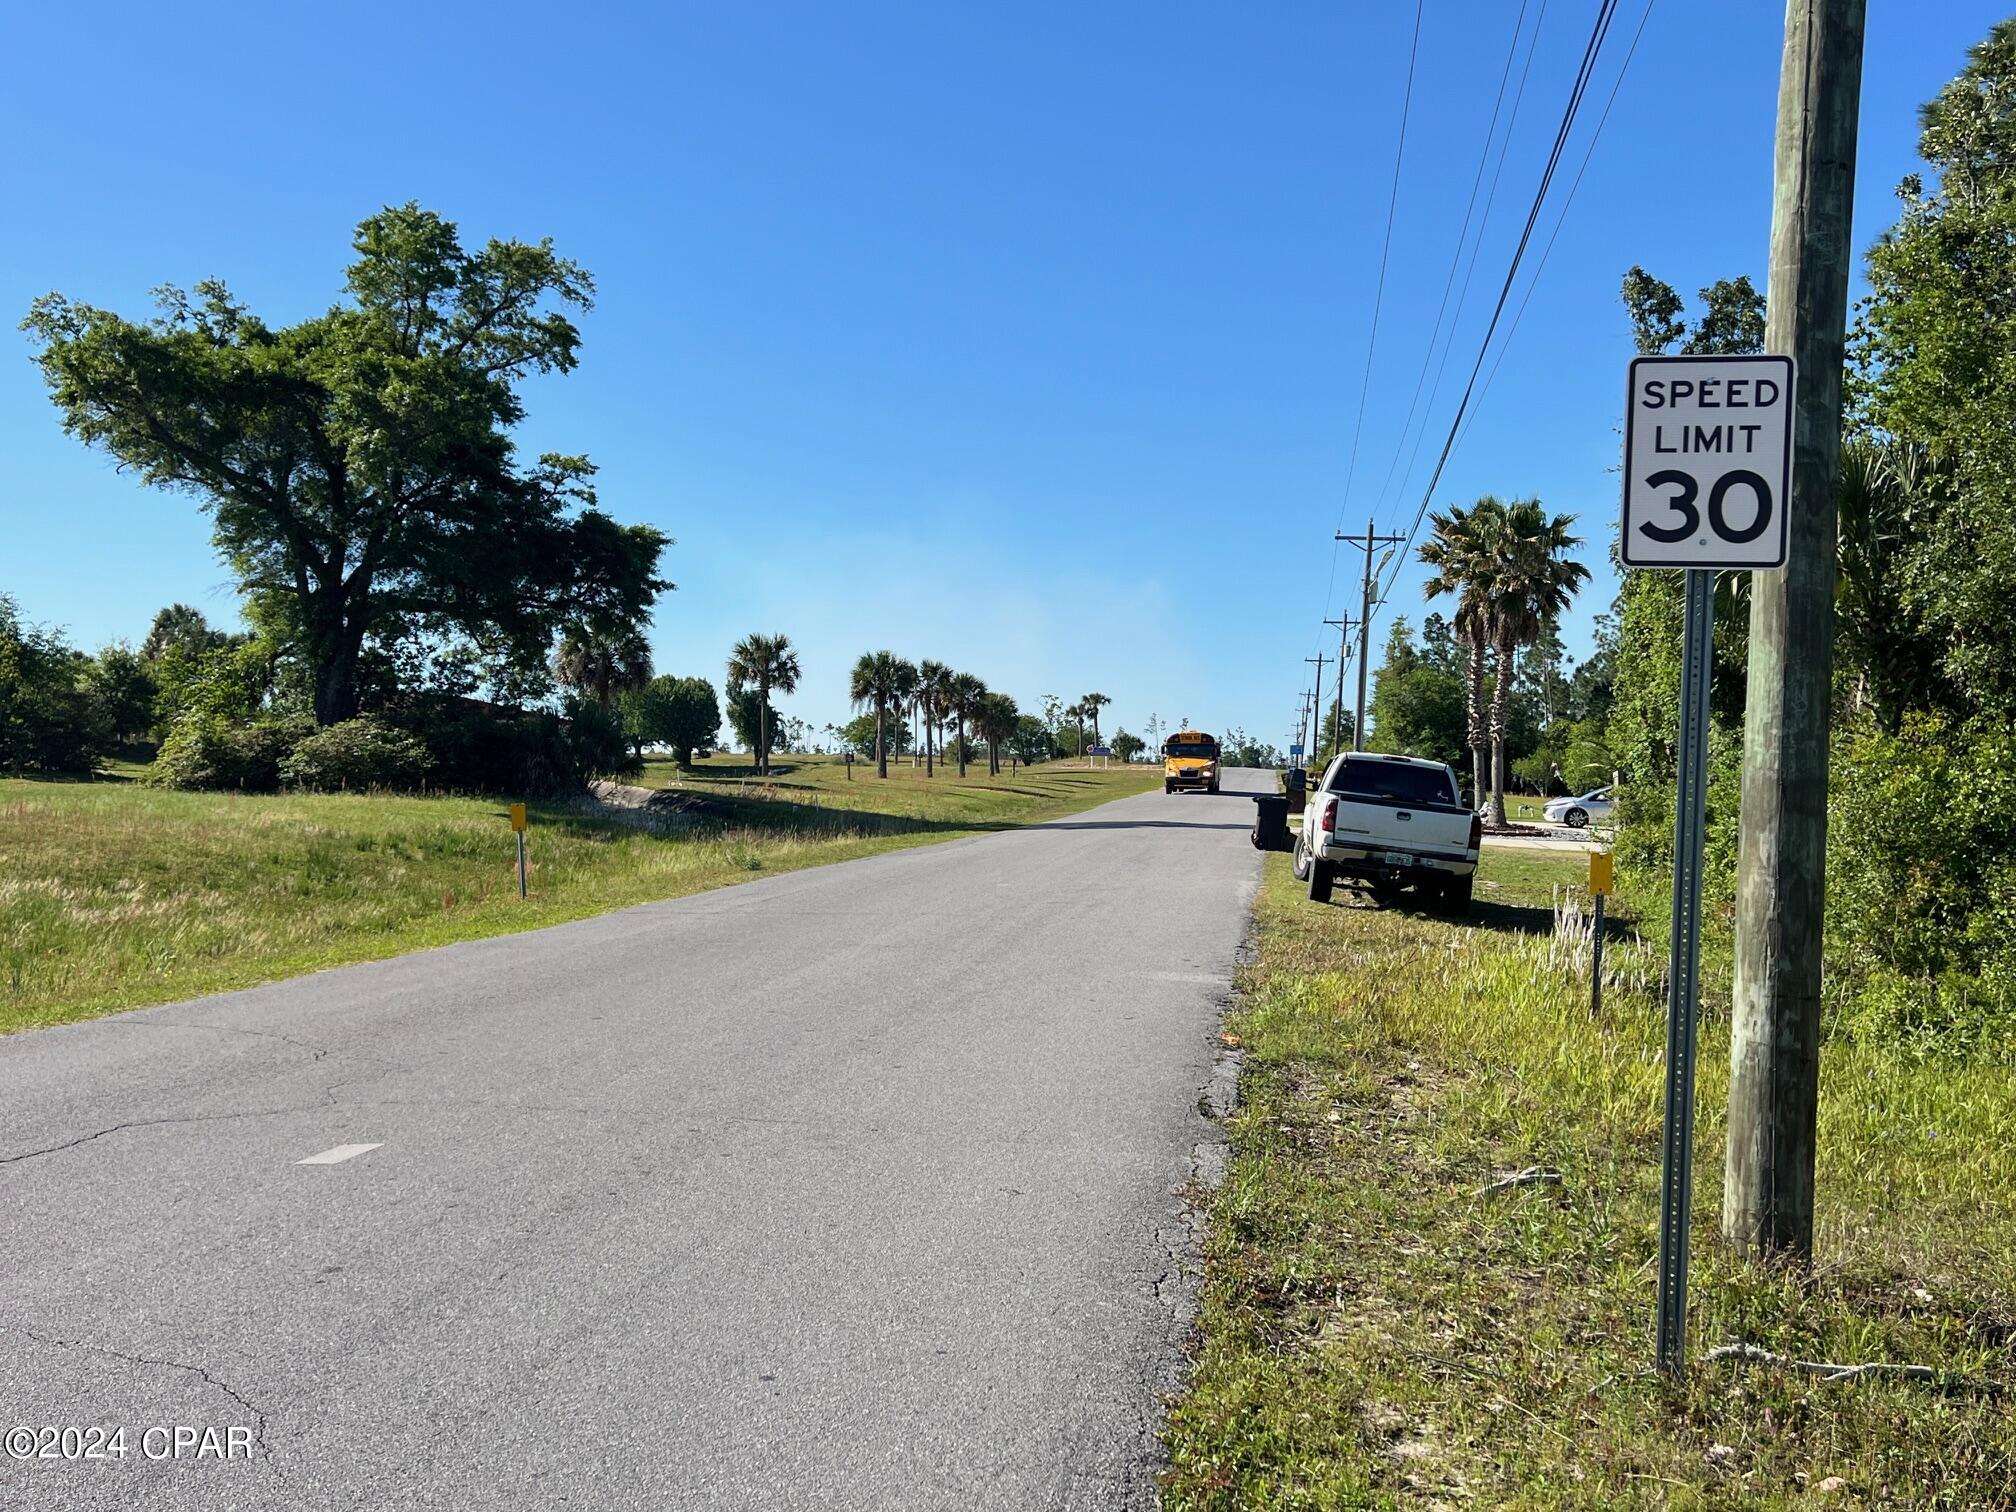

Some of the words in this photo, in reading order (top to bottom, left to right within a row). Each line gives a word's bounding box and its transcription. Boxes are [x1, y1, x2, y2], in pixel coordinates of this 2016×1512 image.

[1641, 379, 1779, 409] SPEED
[1655, 425, 1762, 453] LIMIT
[1638, 469, 1773, 544] 30
